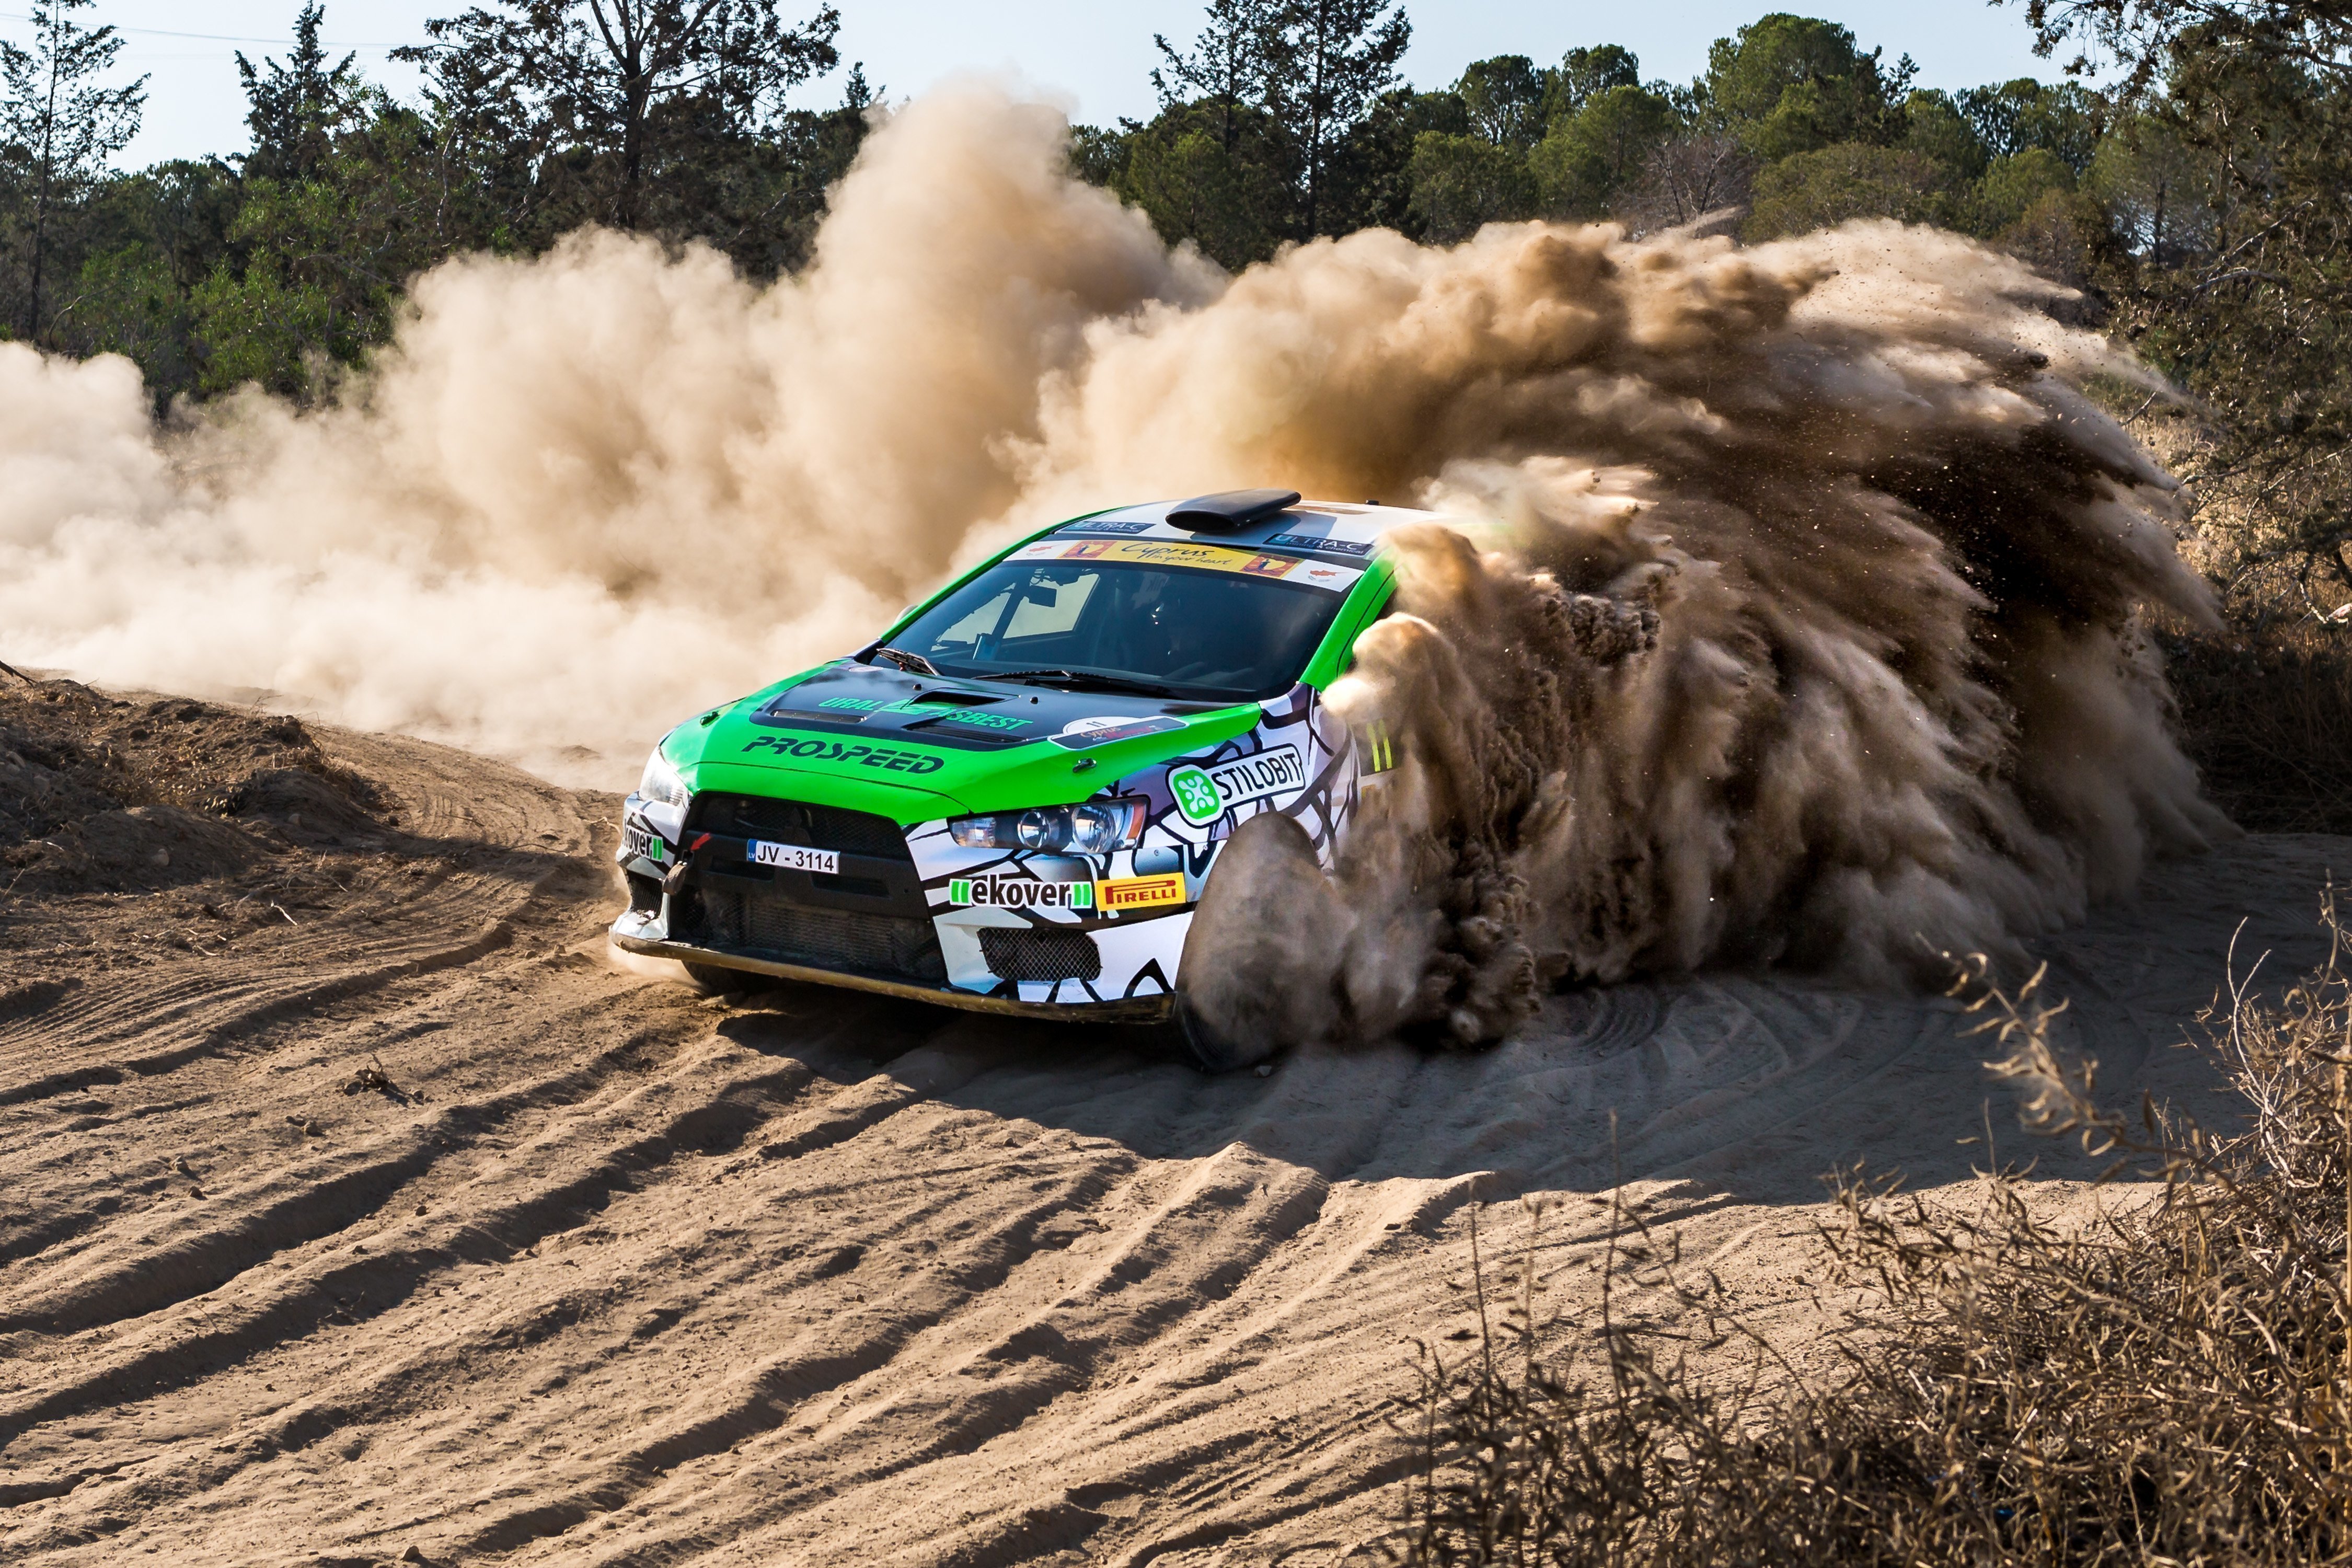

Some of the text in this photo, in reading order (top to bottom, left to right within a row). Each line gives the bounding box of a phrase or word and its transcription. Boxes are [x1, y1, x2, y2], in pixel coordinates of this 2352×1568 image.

[1075, 522, 1146, 530] ULTRA-C
[1122, 543, 1214, 559] Cyprus
[1275, 535, 1362, 550] ULTRA-C
[1325, 546, 1364, 555] chemical
[1195, 556, 1232, 565] heart
[818, 697, 884, 711] URAL
[741, 736, 944, 774] PROSPEED
[1211, 753, 1301, 801] STILOBIT
[624, 818, 652, 857] kover
[757, 845, 779, 863] JV
[795, 850, 834, 871] 3114
[971, 874, 1071, 907] ekover
[1105, 880, 1176, 904] PIRELLI
